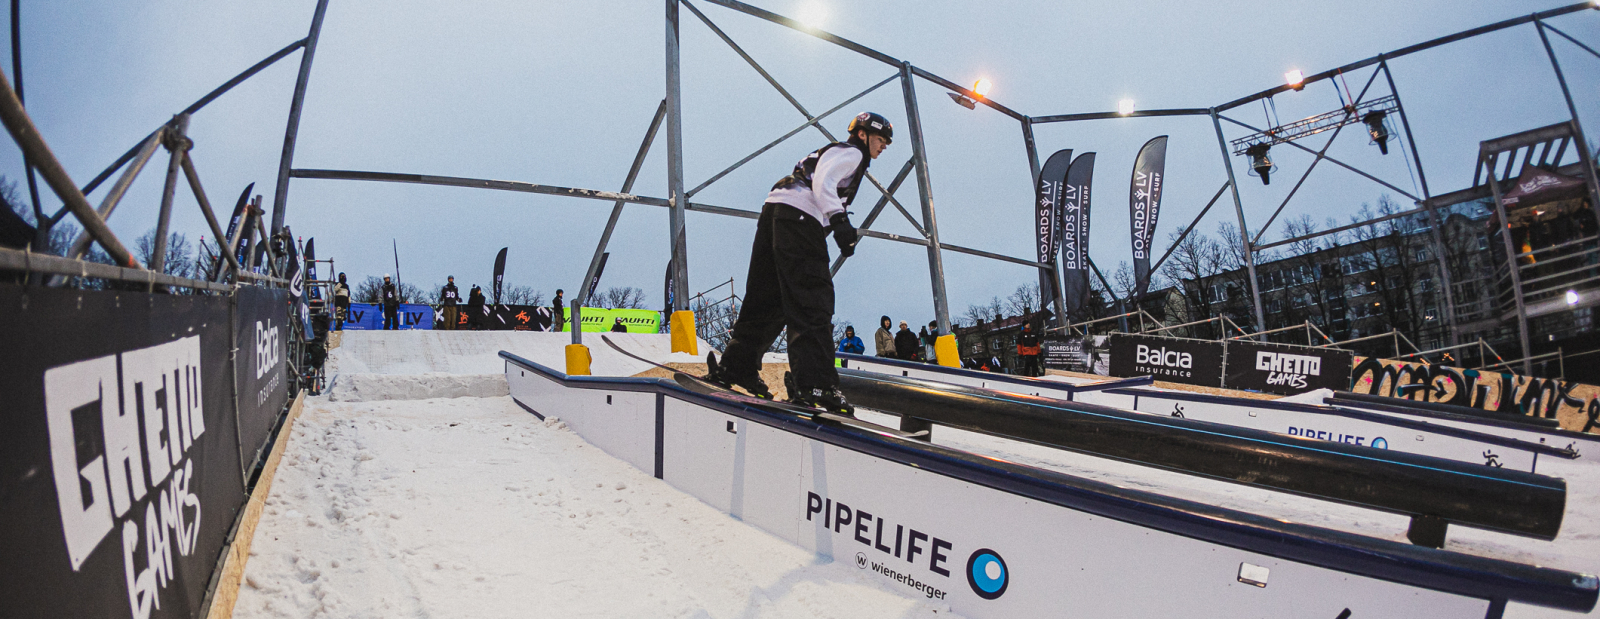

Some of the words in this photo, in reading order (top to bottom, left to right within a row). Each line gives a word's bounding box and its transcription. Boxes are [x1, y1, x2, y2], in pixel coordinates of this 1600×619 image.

[1041, 179, 1051, 195] LV
[1066, 184, 1077, 199] LV
[1136, 170, 1147, 187] LV
[1153, 172, 1161, 191] SURF
[1040, 209, 1050, 263] BOARDS
[1066, 214, 1076, 270] BOARDS
[1134, 202, 1145, 259] BOARDS
[256, 319, 279, 380] Balcia
[1136, 344, 1193, 369] Balcia
[1255, 351, 1322, 376] GHETTO
[1135, 366, 1192, 378] insurance
[1266, 371, 1308, 389] GAMES
[44, 334, 206, 572] GHETTO
[122, 458, 201, 619] GAMES
[806, 490, 953, 578] PIPELIFE
[871, 560, 947, 601] wienerberger
